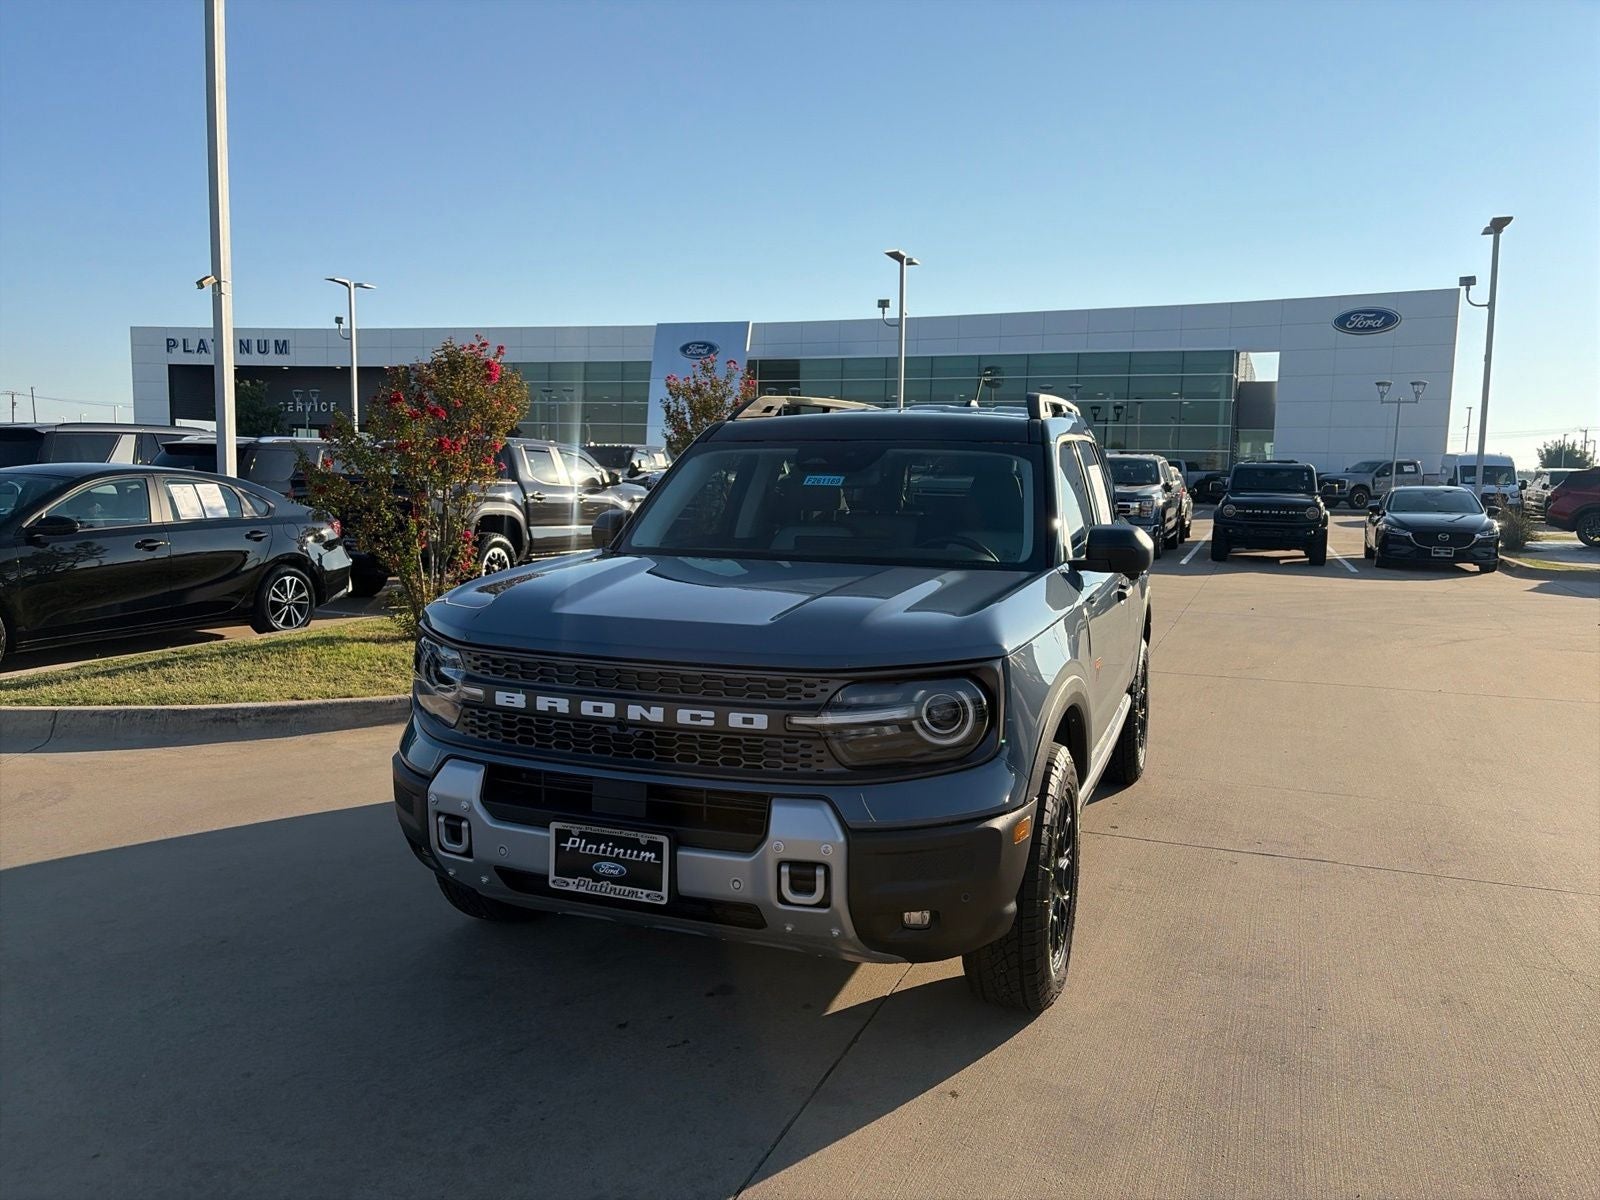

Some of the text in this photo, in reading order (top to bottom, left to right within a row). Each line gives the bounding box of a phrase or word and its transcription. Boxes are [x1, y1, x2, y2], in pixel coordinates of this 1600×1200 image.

[1346, 313, 1385, 328] Ford
[166, 338, 290, 355] PLANUM
[687, 344, 709, 354] Ford
[279, 401, 337, 413] SERVICE
[495, 690, 768, 730] BRONCO
[560, 837, 661, 863] Platinum
[599, 864, 620, 875] Ford
